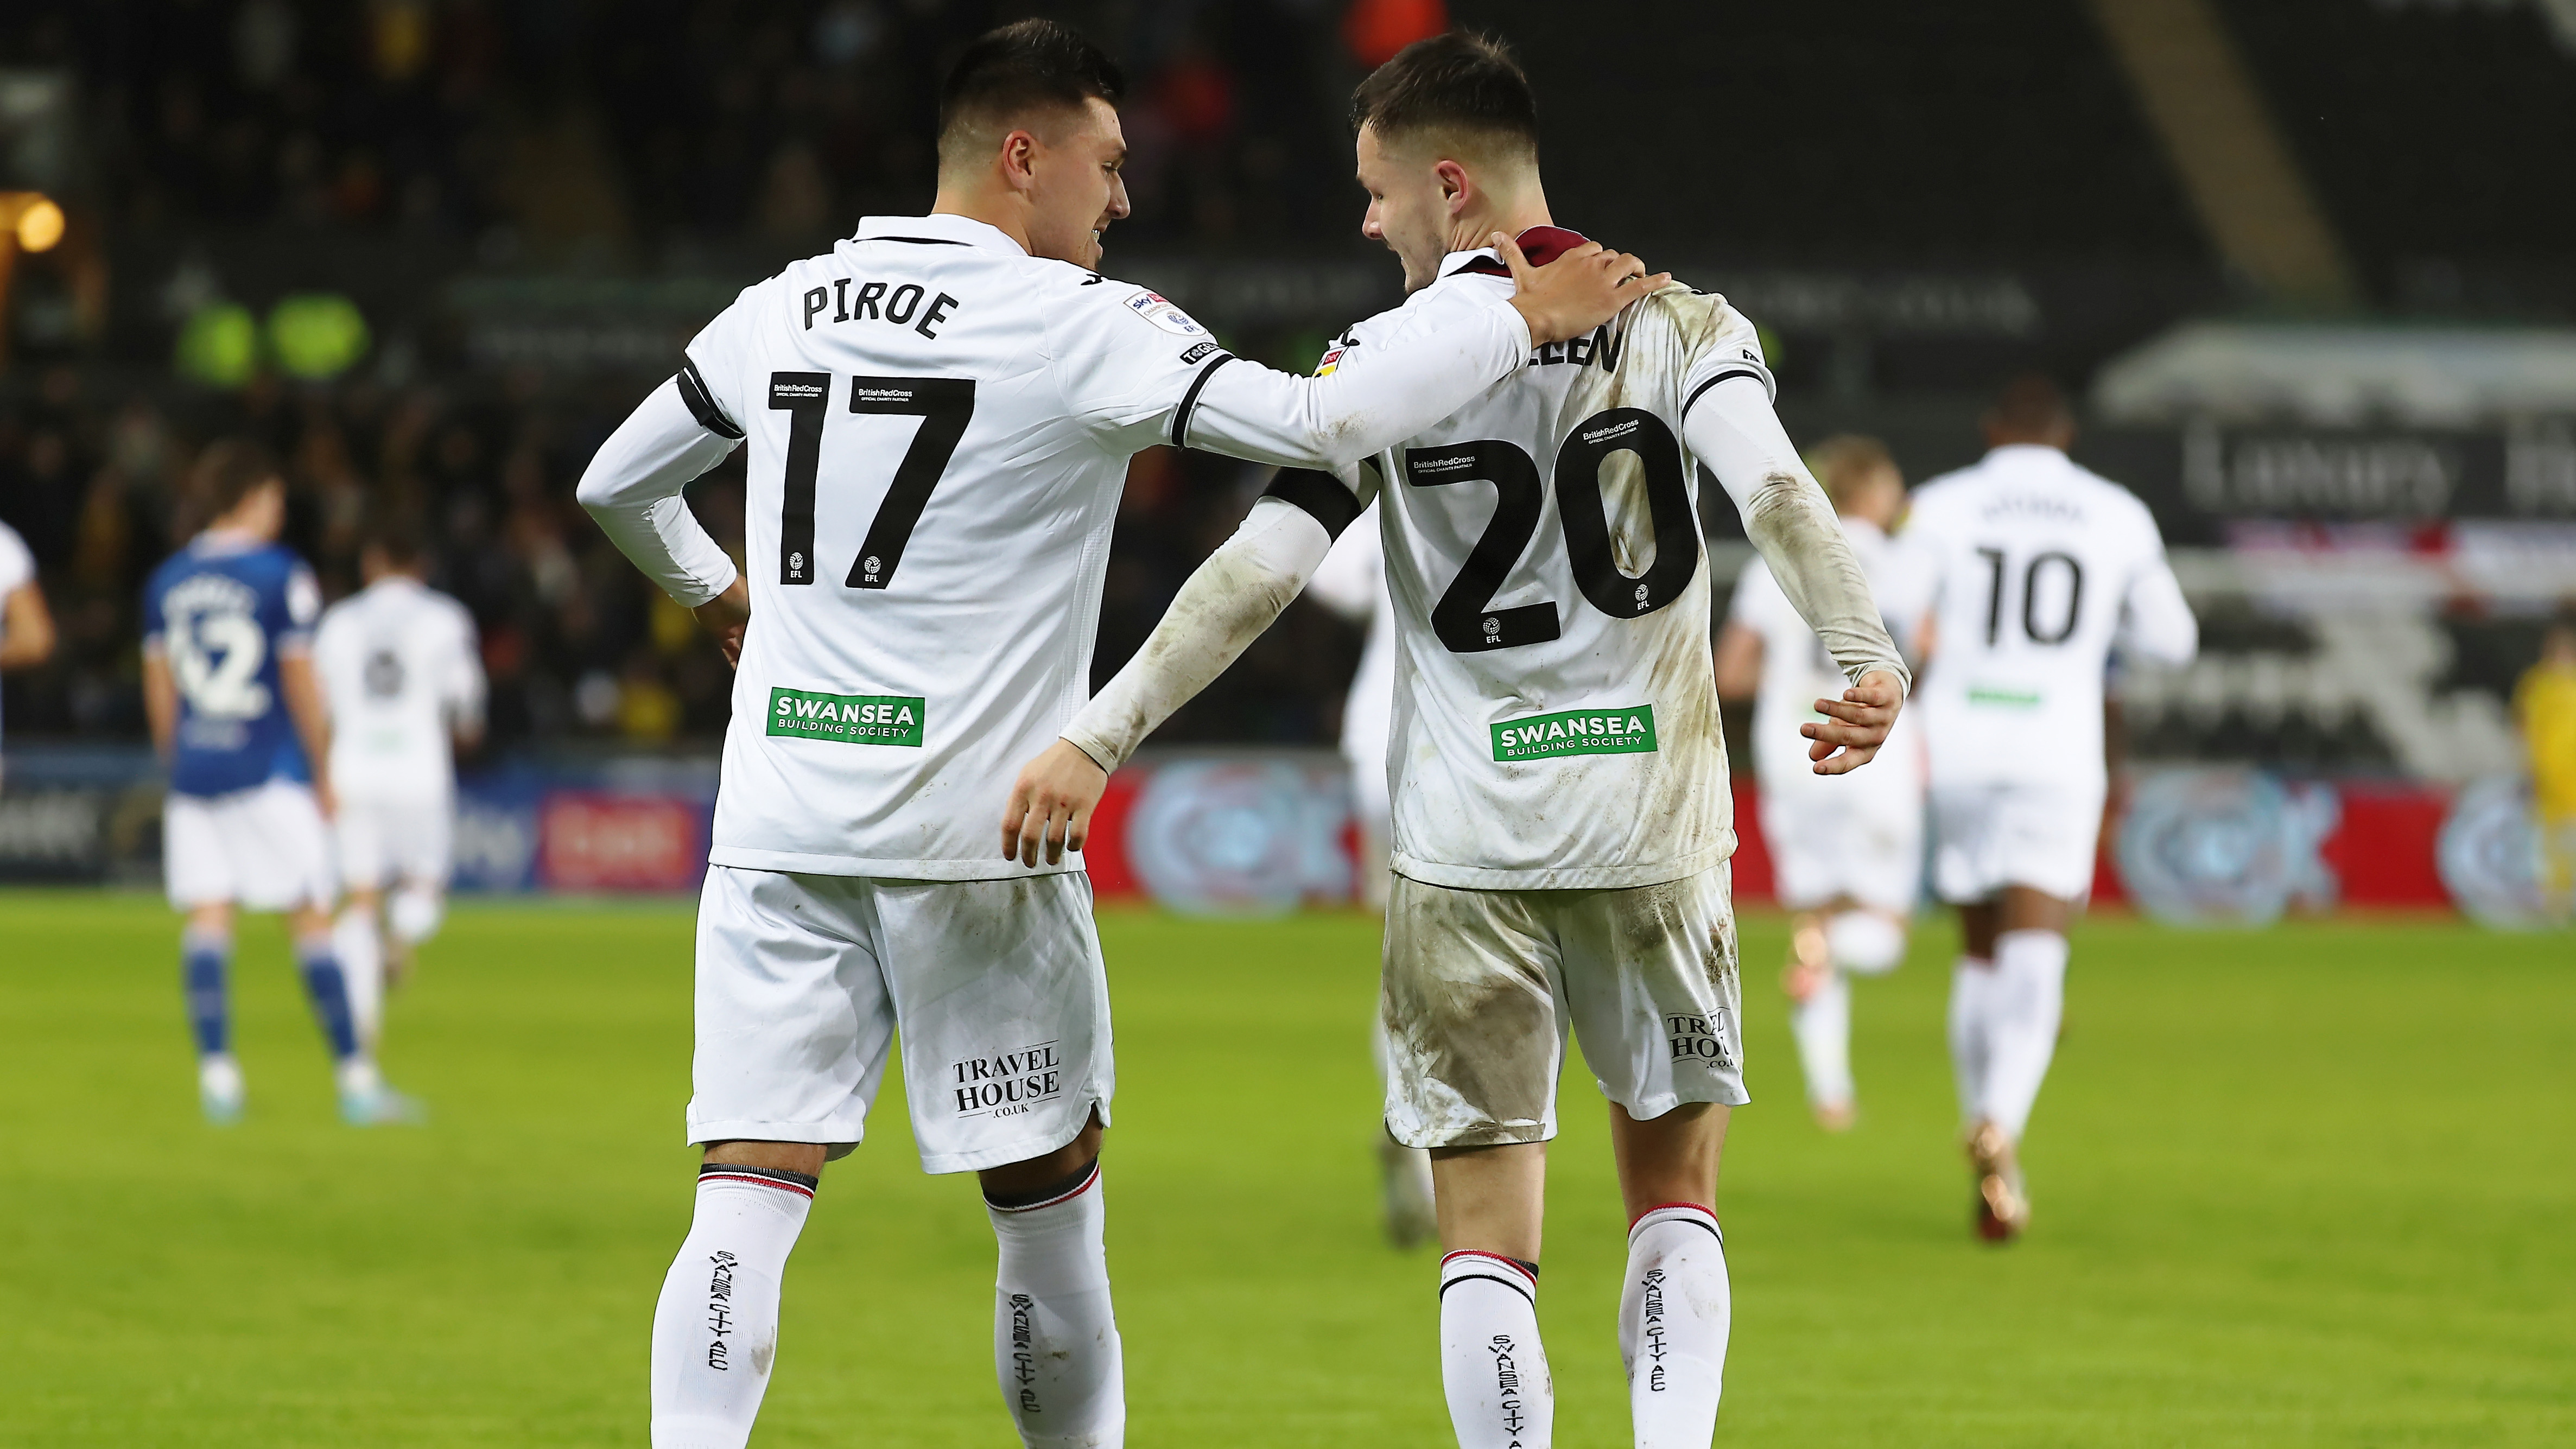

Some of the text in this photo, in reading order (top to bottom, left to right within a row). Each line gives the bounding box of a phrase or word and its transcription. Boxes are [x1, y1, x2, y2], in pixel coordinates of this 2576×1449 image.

[804, 278, 959, 340] PIROE
[1133, 297, 1152, 309] sky
[1528, 325, 1623, 373] LEN
[768, 371, 976, 589] 17
[1405, 407, 1698, 654] 20
[865, 574, 878, 582] EFL
[1637, 600, 1649, 611] EFL
[1975, 545, 2085, 650] 10
[1486, 635, 1501, 644] EFL
[775, 696, 915, 726] SWANSEA
[777, 719, 909, 738] BUILDING SOCIETY
[1500, 715, 1647, 747] SWANSEA
[1507, 736, 1642, 757] BUILDING SOCIETY
[953, 1046, 1059, 1083] TRAVEL
[954, 1070, 1059, 1112] HOUSE
[993, 1103, 1029, 1118] .CO.UK
